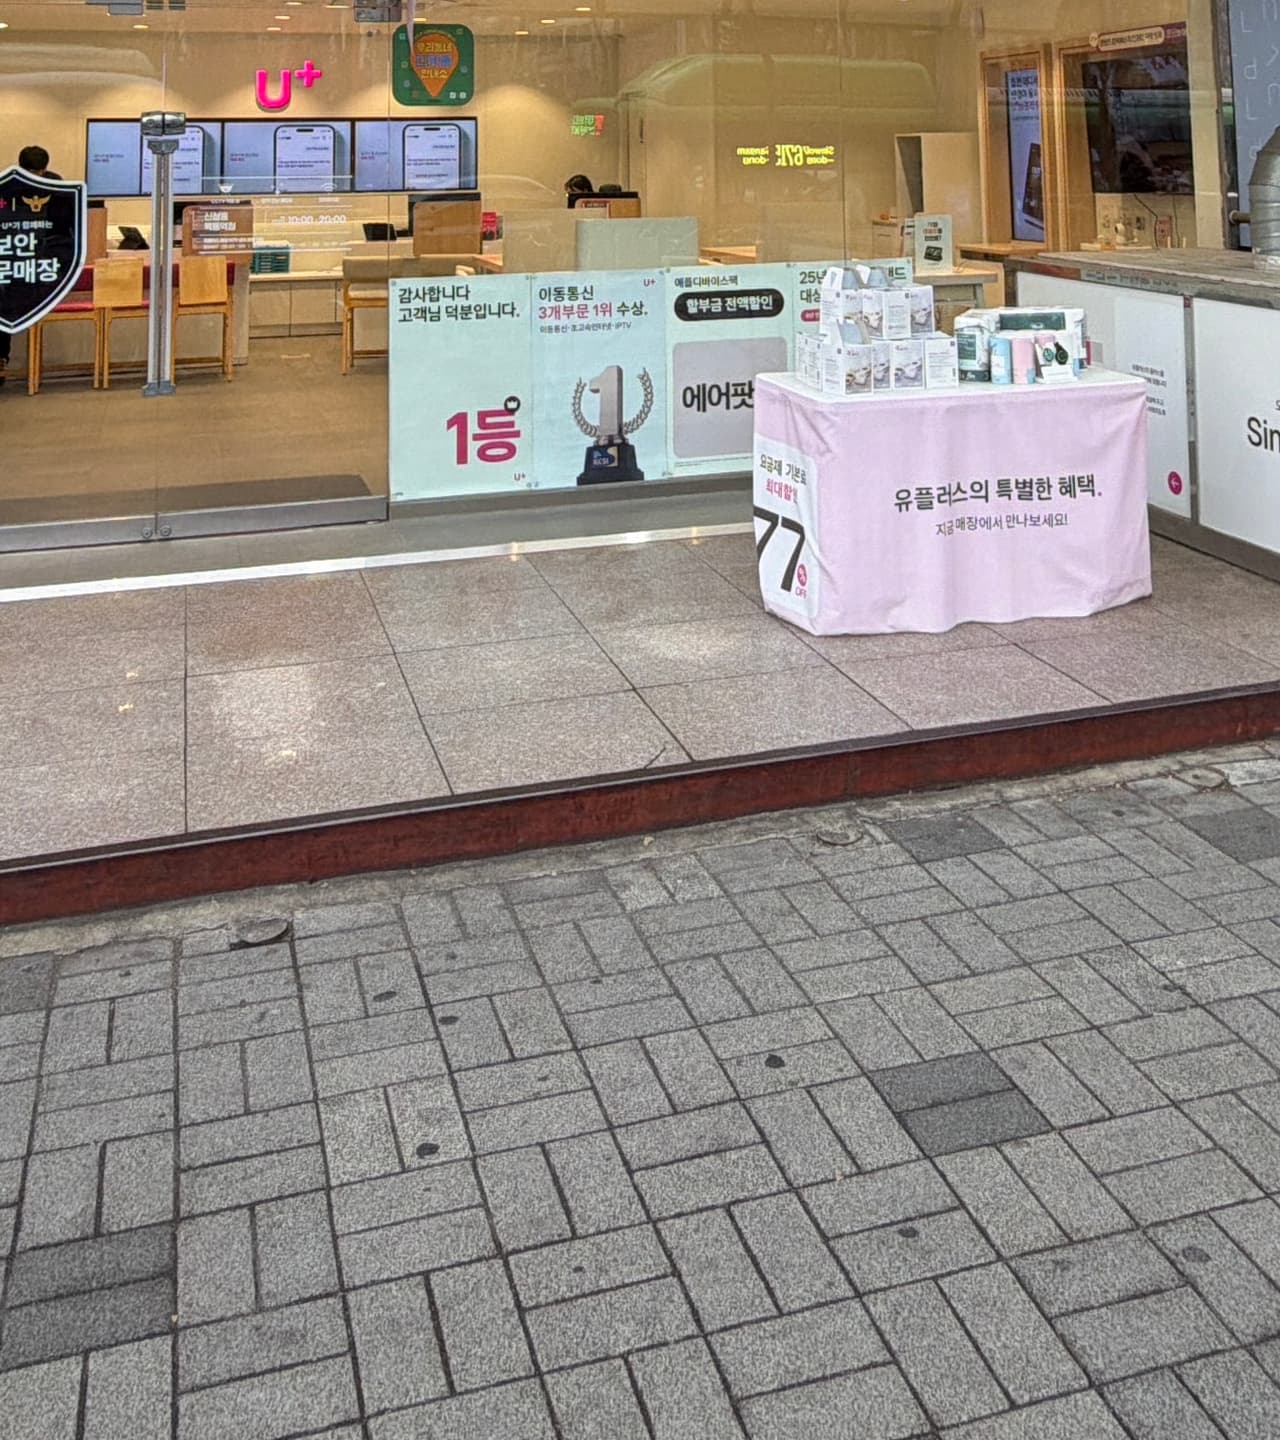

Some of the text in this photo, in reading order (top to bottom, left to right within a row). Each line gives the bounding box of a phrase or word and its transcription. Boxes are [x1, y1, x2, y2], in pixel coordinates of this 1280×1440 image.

[255, 59, 322, 110] U+
[397, 284, 472, 304] 감사합니다
[538, 284, 595, 304] 이동통신
[397, 301, 520, 324] 고객님 덕분입니다.
[537, 300, 649, 321] 3개부문 1위 수상.
[681, 381, 755, 413] 에어팟
[445, 406, 521, 466] 1등
[893, 473, 1103, 513] 유플러스의 특별한 혜택.
[935, 513, 1069, 537] 지금 매장에서 만나보세요!
